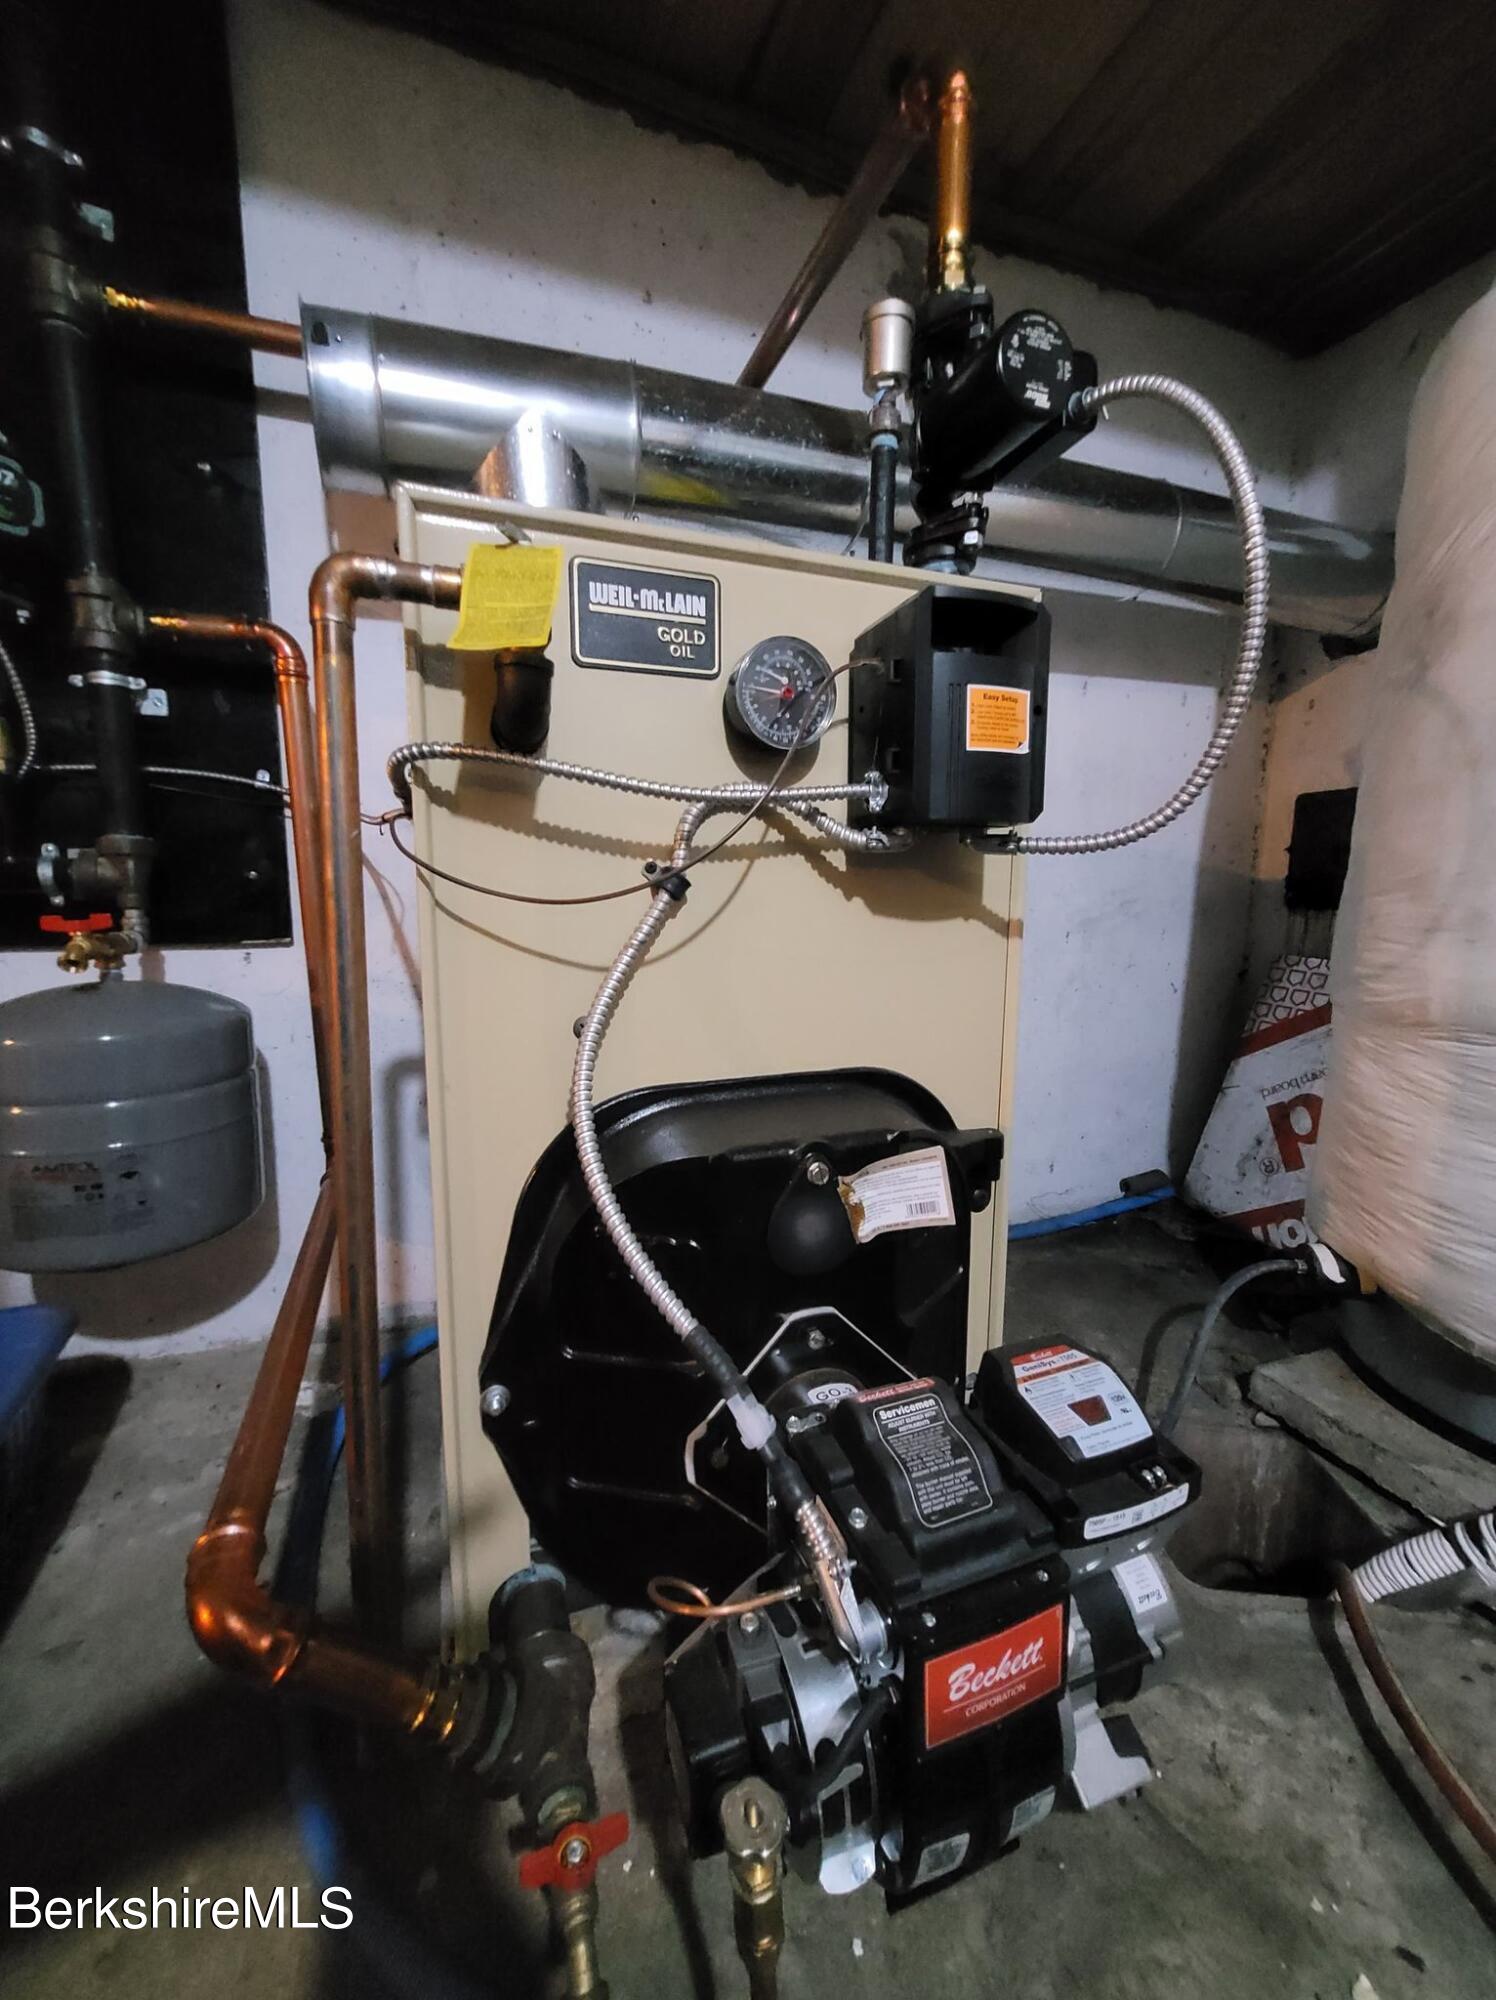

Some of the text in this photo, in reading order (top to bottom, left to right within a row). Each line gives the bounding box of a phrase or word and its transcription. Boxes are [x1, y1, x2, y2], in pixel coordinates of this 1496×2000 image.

[657, 626, 706, 646] GOLD
[669, 645, 696, 659] OIL
[983, 693, 1019, 704] Easy Setup
[879, 1399, 937, 1420] Servicemen
[948, 1636, 1044, 1702] Beckett
[965, 1683, 1026, 1718] CORPORATION
